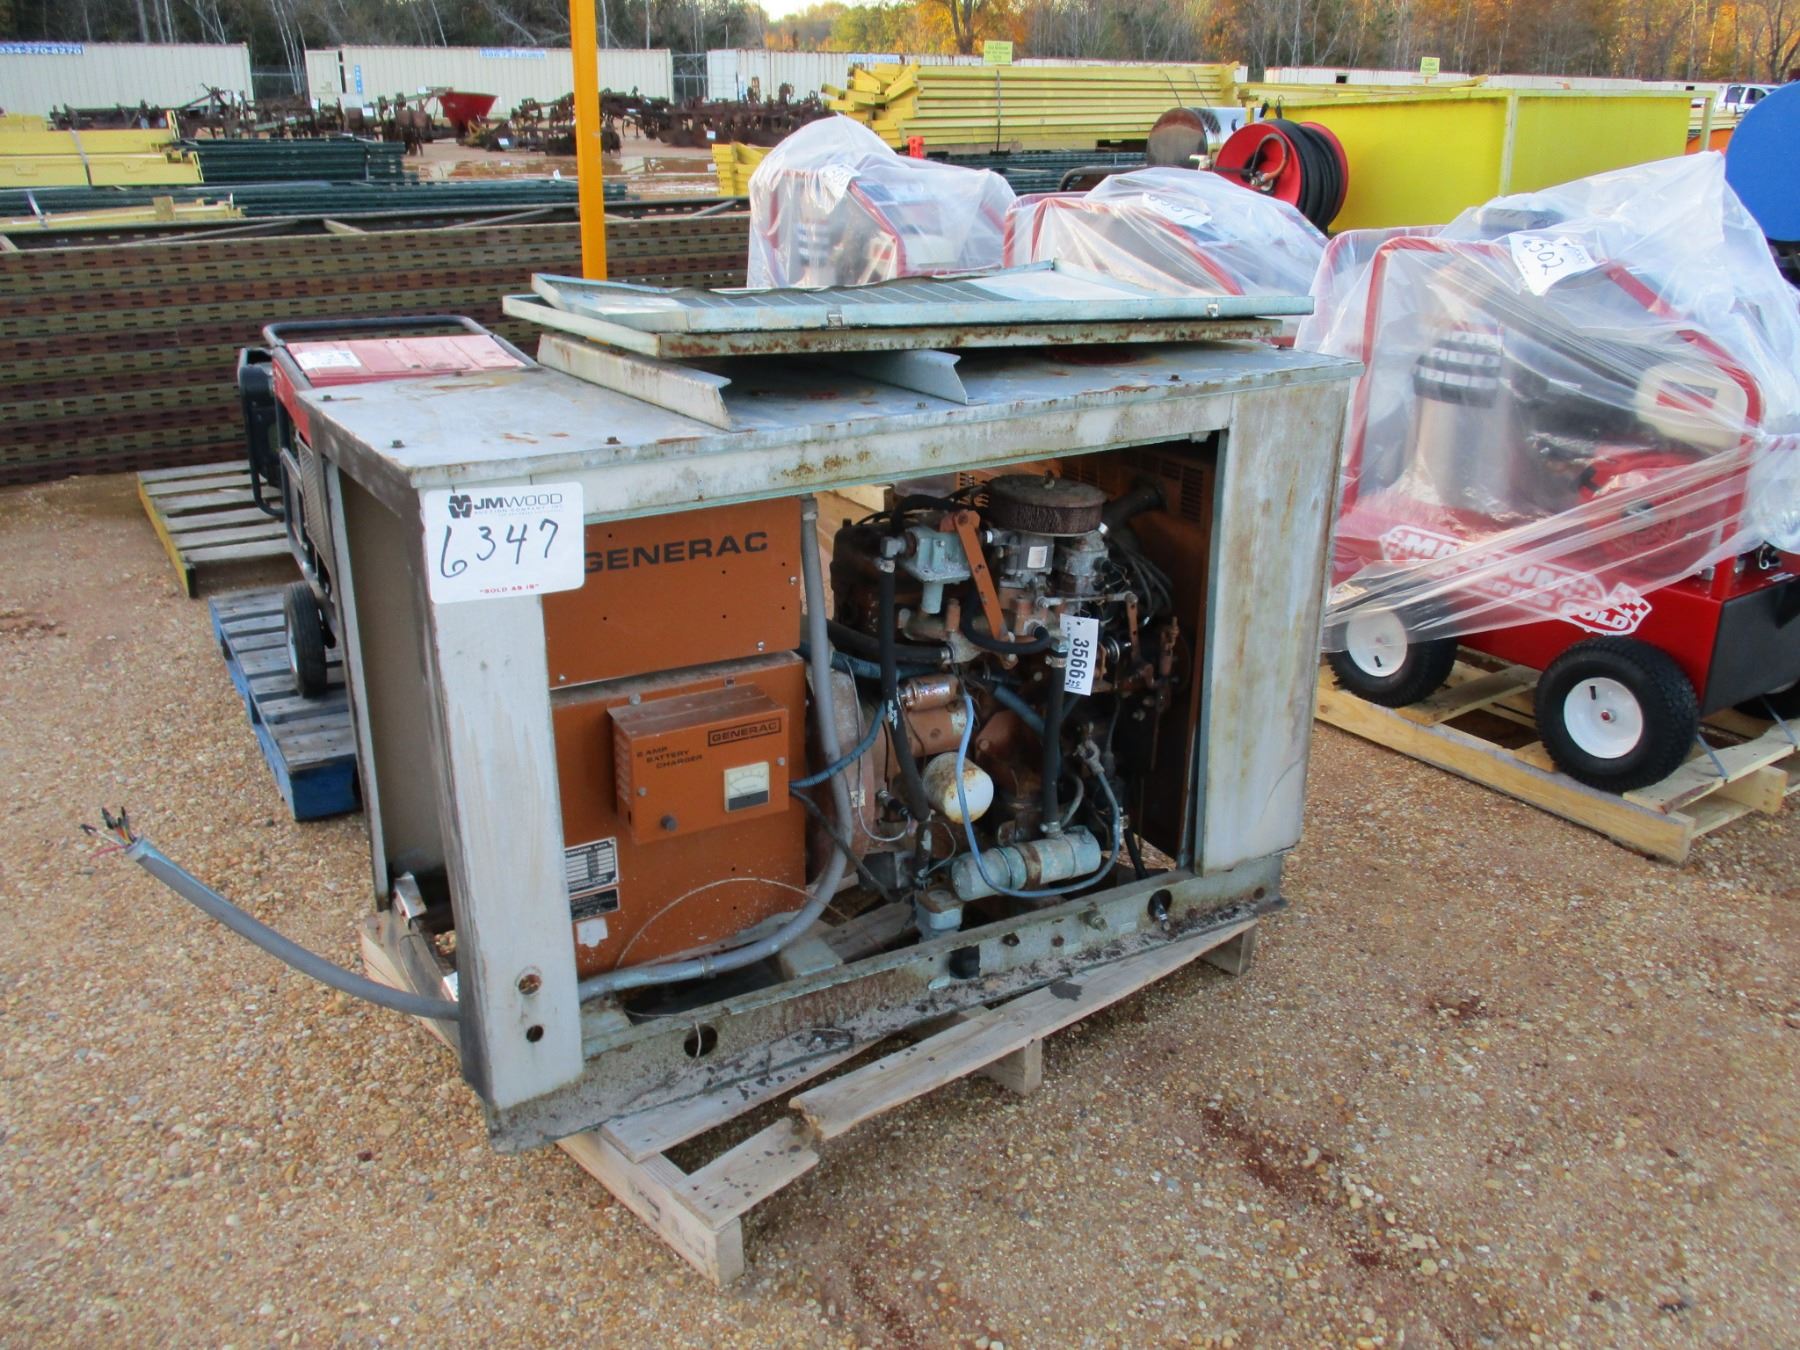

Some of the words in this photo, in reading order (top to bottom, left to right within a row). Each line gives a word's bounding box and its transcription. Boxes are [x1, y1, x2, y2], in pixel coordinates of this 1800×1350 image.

[440, 518, 558, 578] 6347
[584, 531, 768, 574] GENERAC
[1069, 638, 1090, 679] 3566
[711, 722, 777, 742] GENERAC
[646, 746, 668, 755] AMP
[646, 750, 690, 763] BATTERY
[656, 754, 703, 768] CHARGER
